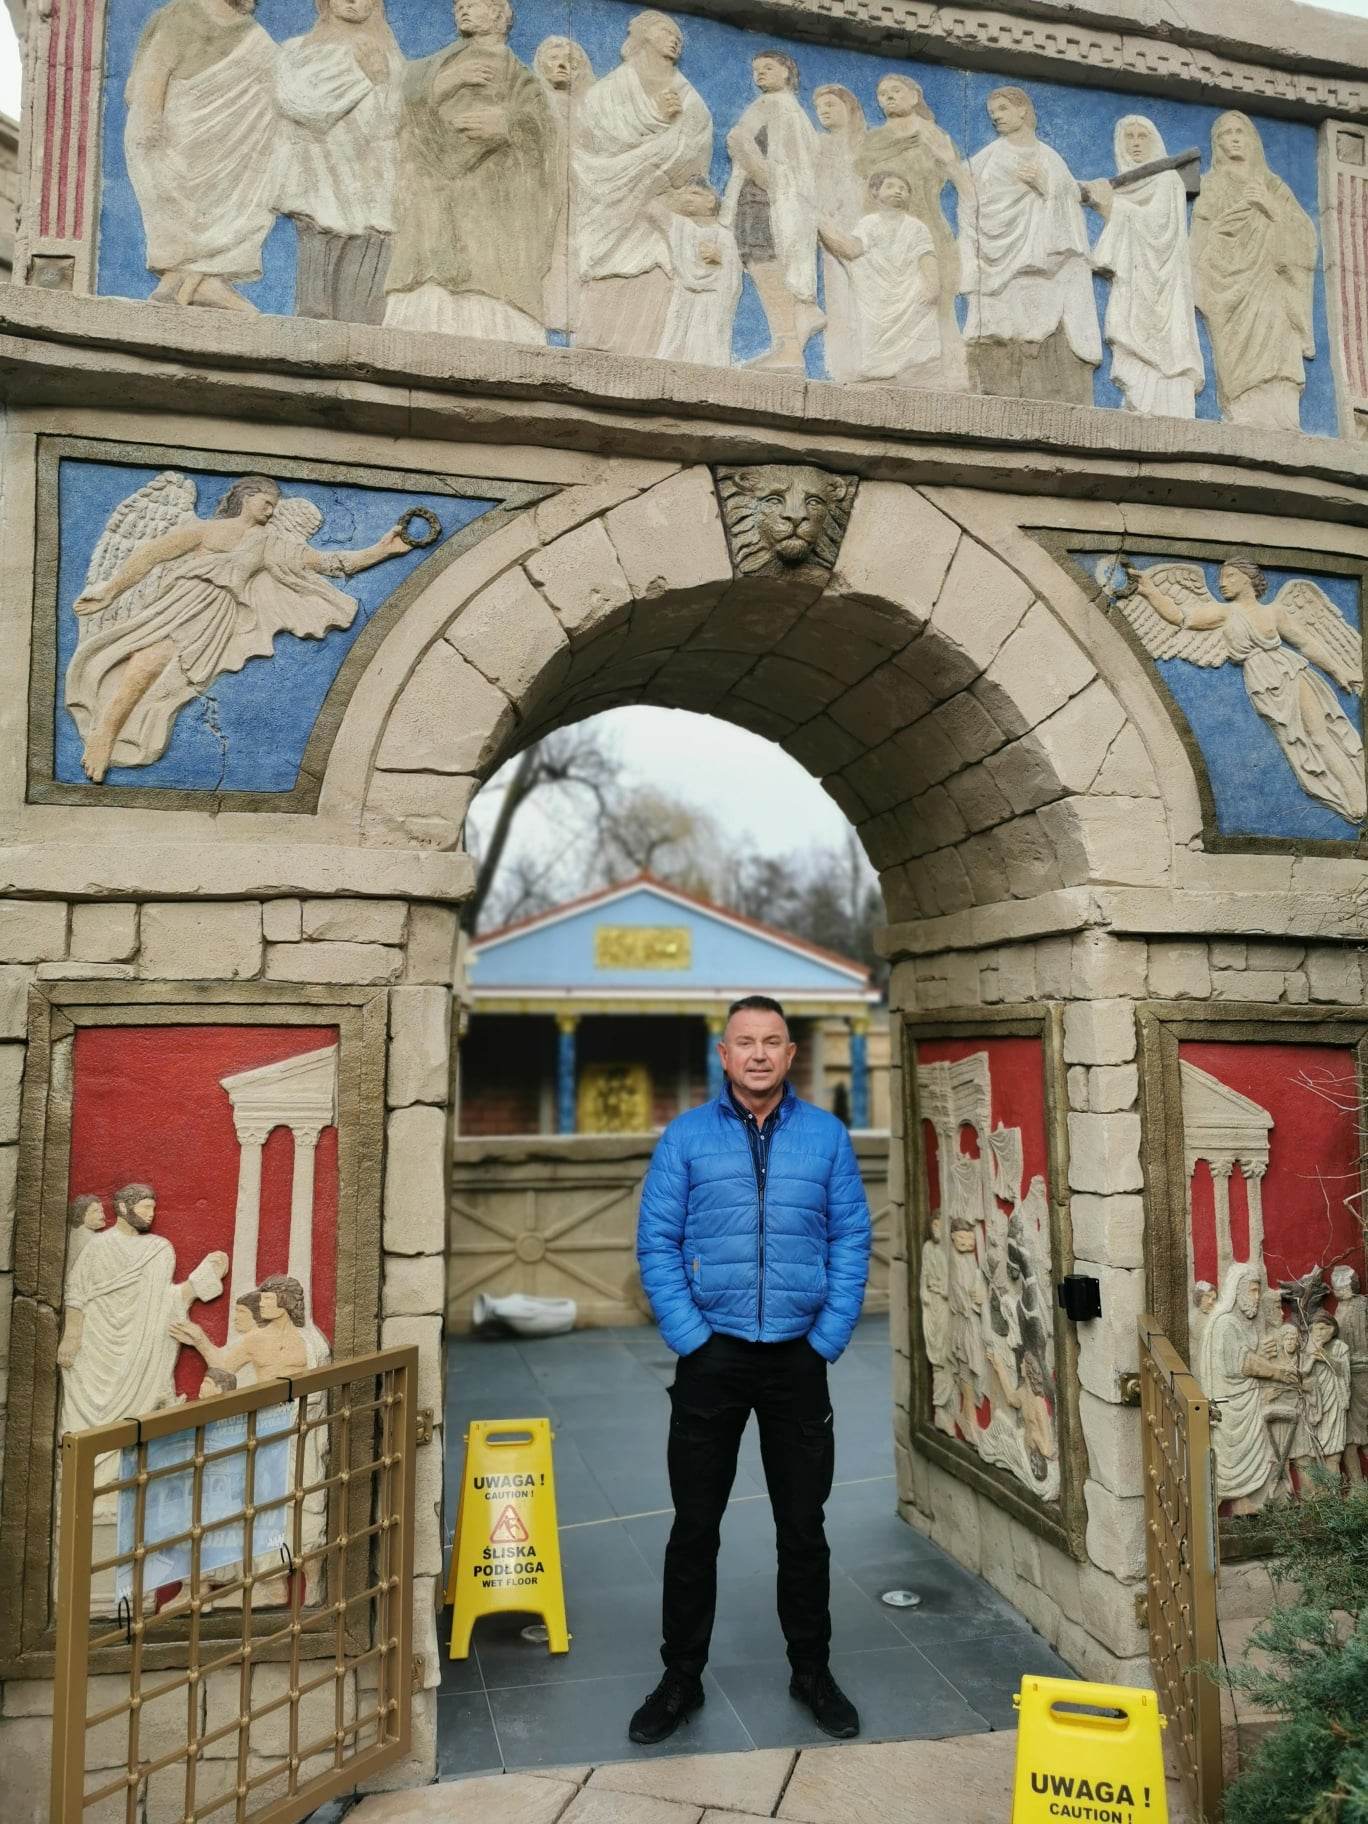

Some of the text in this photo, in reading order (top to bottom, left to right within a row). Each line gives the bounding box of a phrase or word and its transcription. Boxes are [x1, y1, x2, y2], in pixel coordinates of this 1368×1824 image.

[473, 1473, 545, 1490] UWAGA !
[485, 1490, 528, 1500] CAUTION
[482, 1545, 537, 1560] ŚLISKA
[473, 1561, 545, 1577] PODŁOGA
[482, 1577, 538, 1588] WET FLOOR
[1031, 1772, 1150, 1808] UWAGA !
[1050, 1803, 1122, 1824] CAUTION
